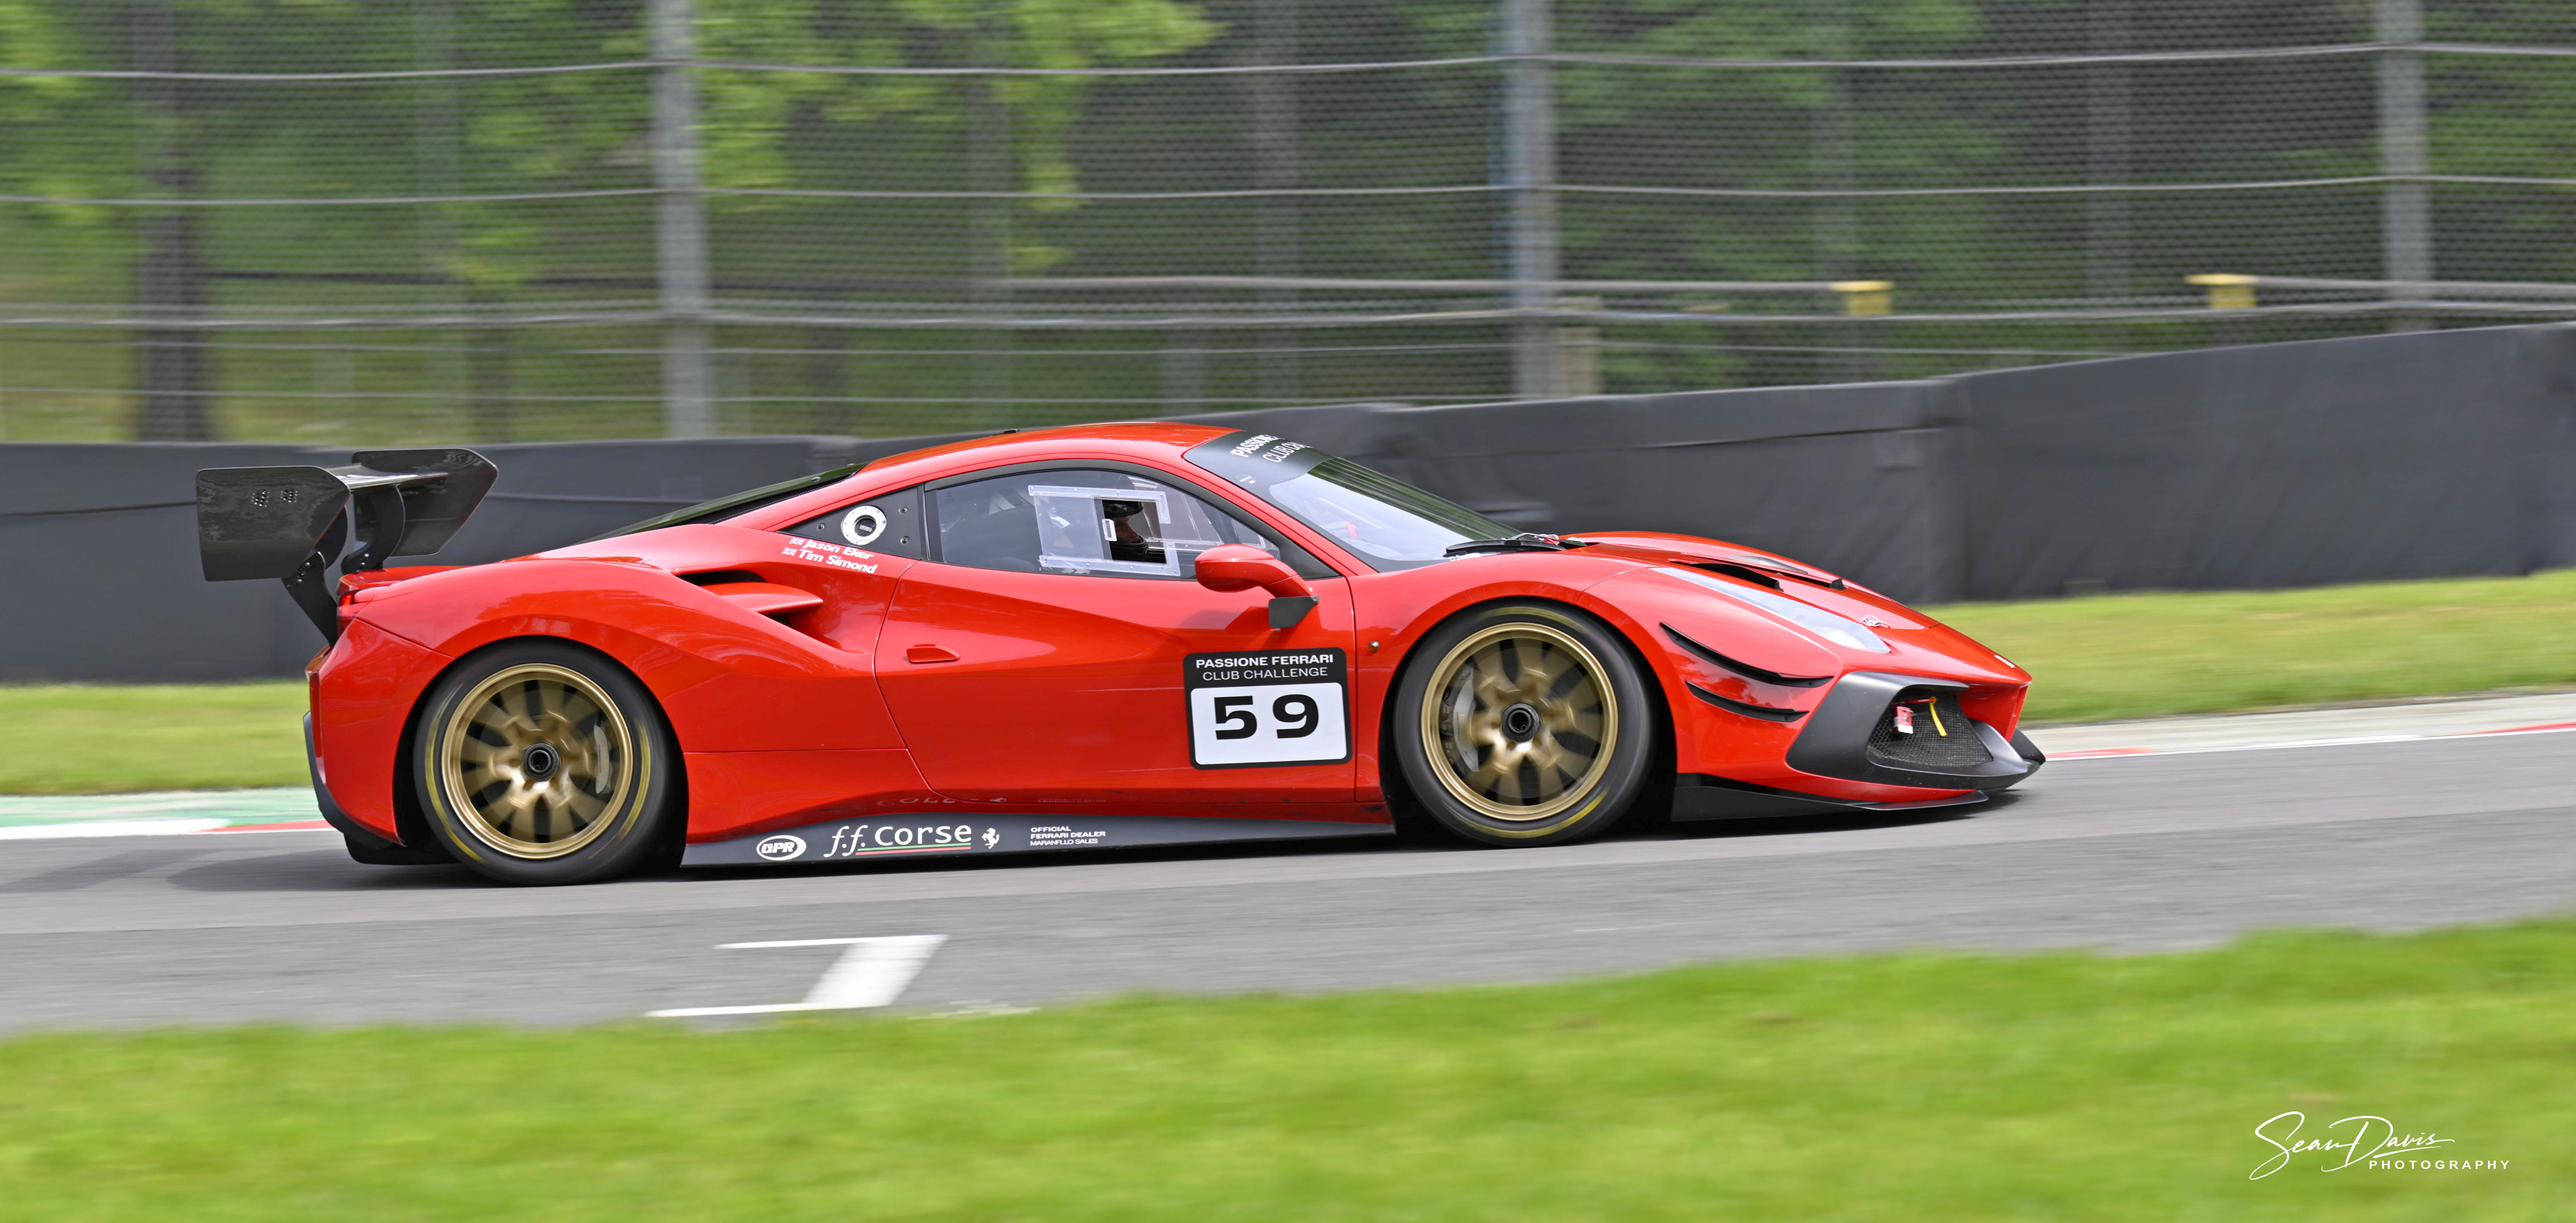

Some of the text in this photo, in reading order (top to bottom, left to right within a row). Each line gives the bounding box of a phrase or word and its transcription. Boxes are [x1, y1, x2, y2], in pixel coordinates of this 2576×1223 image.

[1263, 445, 1294, 463] CLUB
[802, 539, 874, 560] Jason Eker
[798, 549, 878, 574] Tim Simond
[1196, 654, 1334, 669] PASSIONE FERRARI
[1202, 667, 1328, 681] CLUB CHALLENGE
[1214, 694, 1320, 740] 59
[761, 842, 795, 854] GPR
